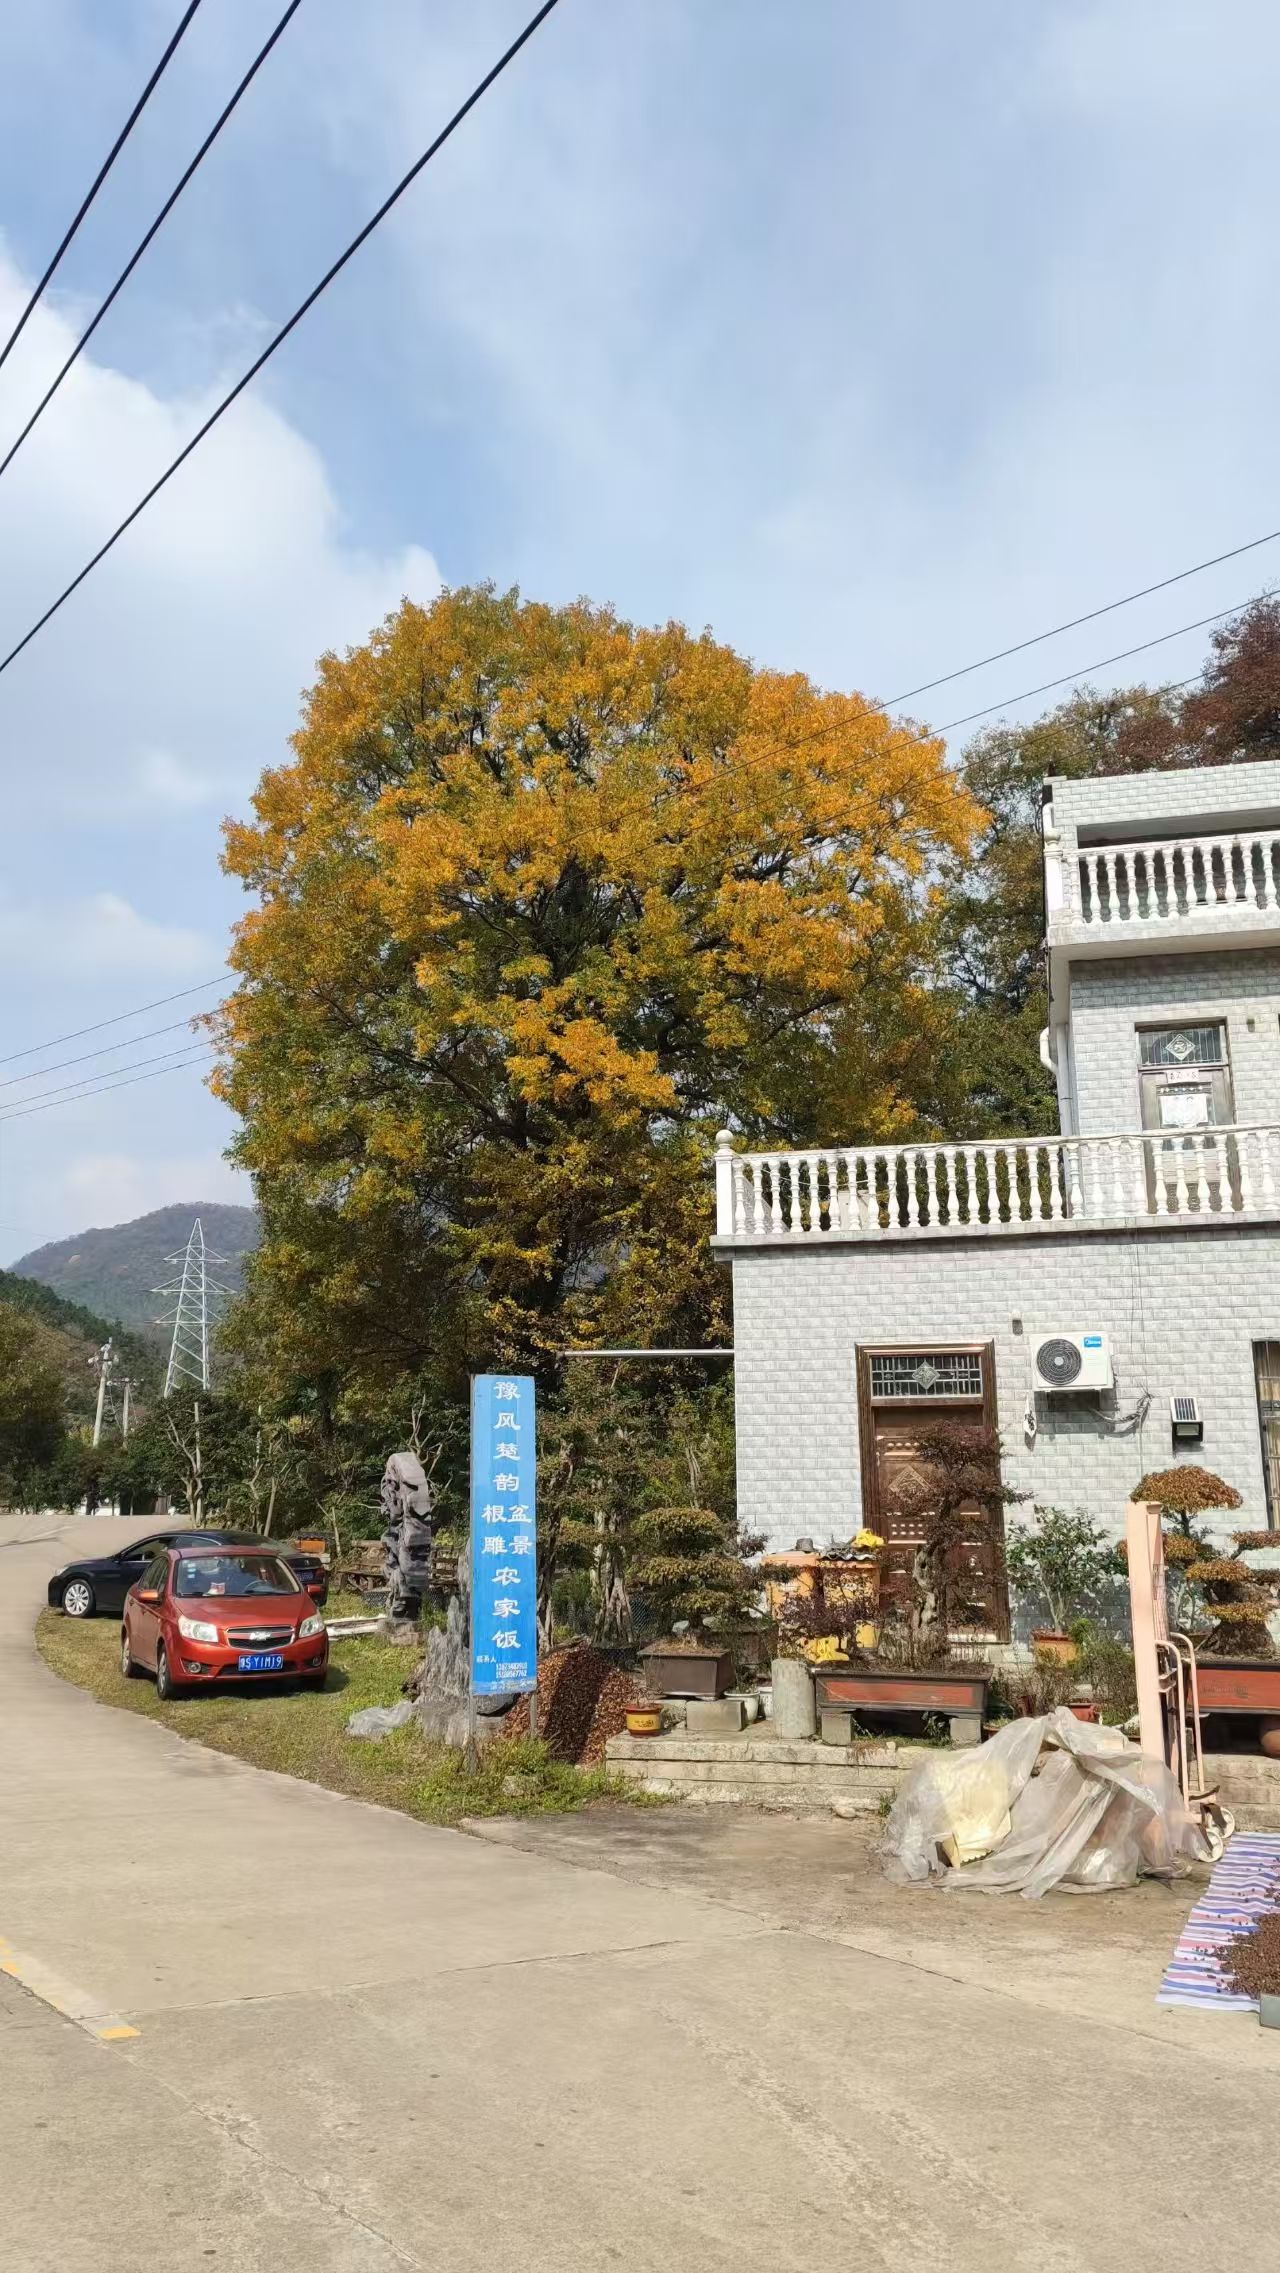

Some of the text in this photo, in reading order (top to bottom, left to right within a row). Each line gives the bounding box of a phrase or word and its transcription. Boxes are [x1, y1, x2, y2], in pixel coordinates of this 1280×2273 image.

[493, 1381, 521, 1492] 豫风楚韵
[481, 1503, 508, 1555] 根雕
[507, 1504, 533, 1555] 盆景
[491, 1566, 521, 1649] 农家饭
